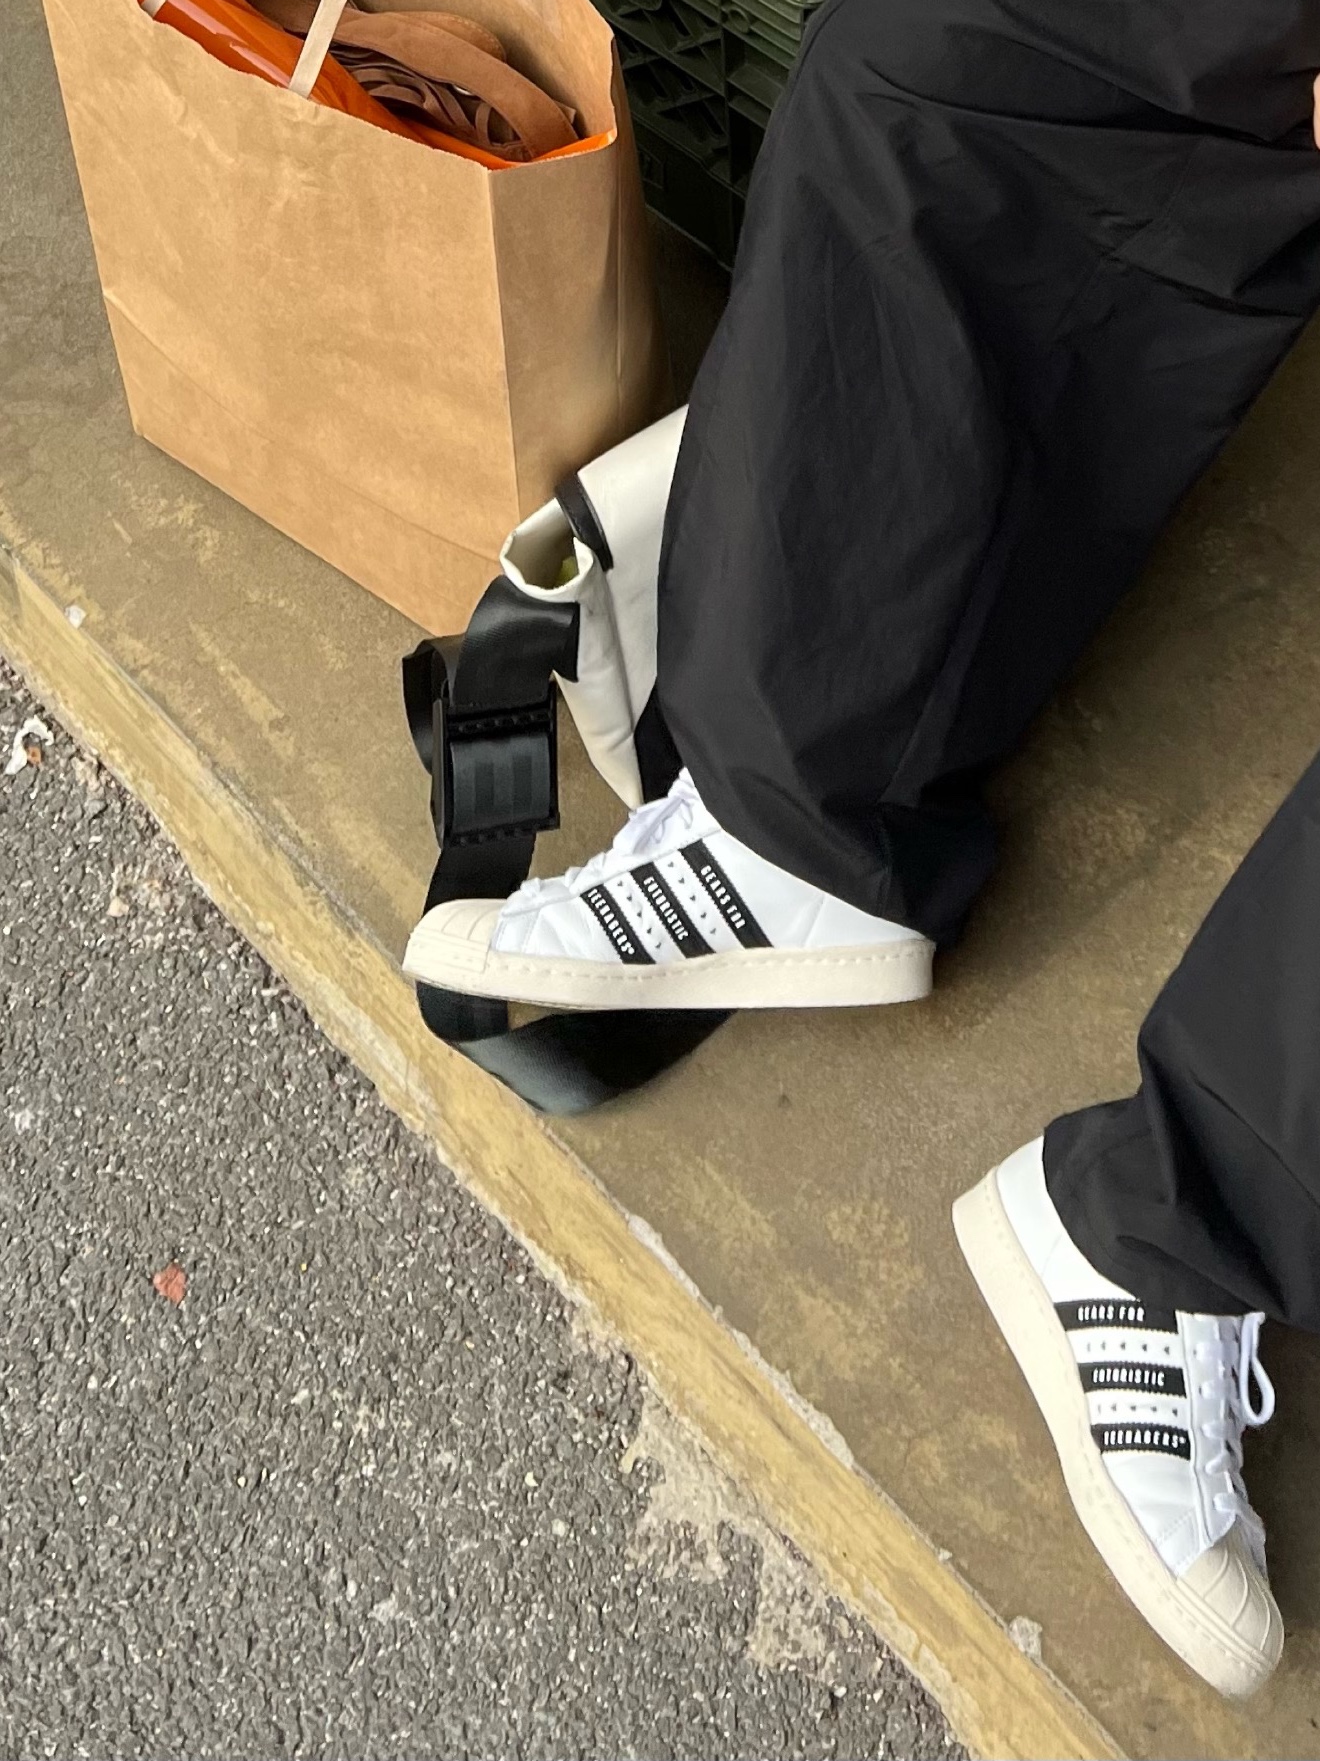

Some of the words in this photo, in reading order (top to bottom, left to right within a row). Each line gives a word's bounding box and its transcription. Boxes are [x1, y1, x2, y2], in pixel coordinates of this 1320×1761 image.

[643, 876, 689, 941] FUTURISTIC
[701, 865, 731, 905] GEARS
[727, 905, 746, 929] FOR
